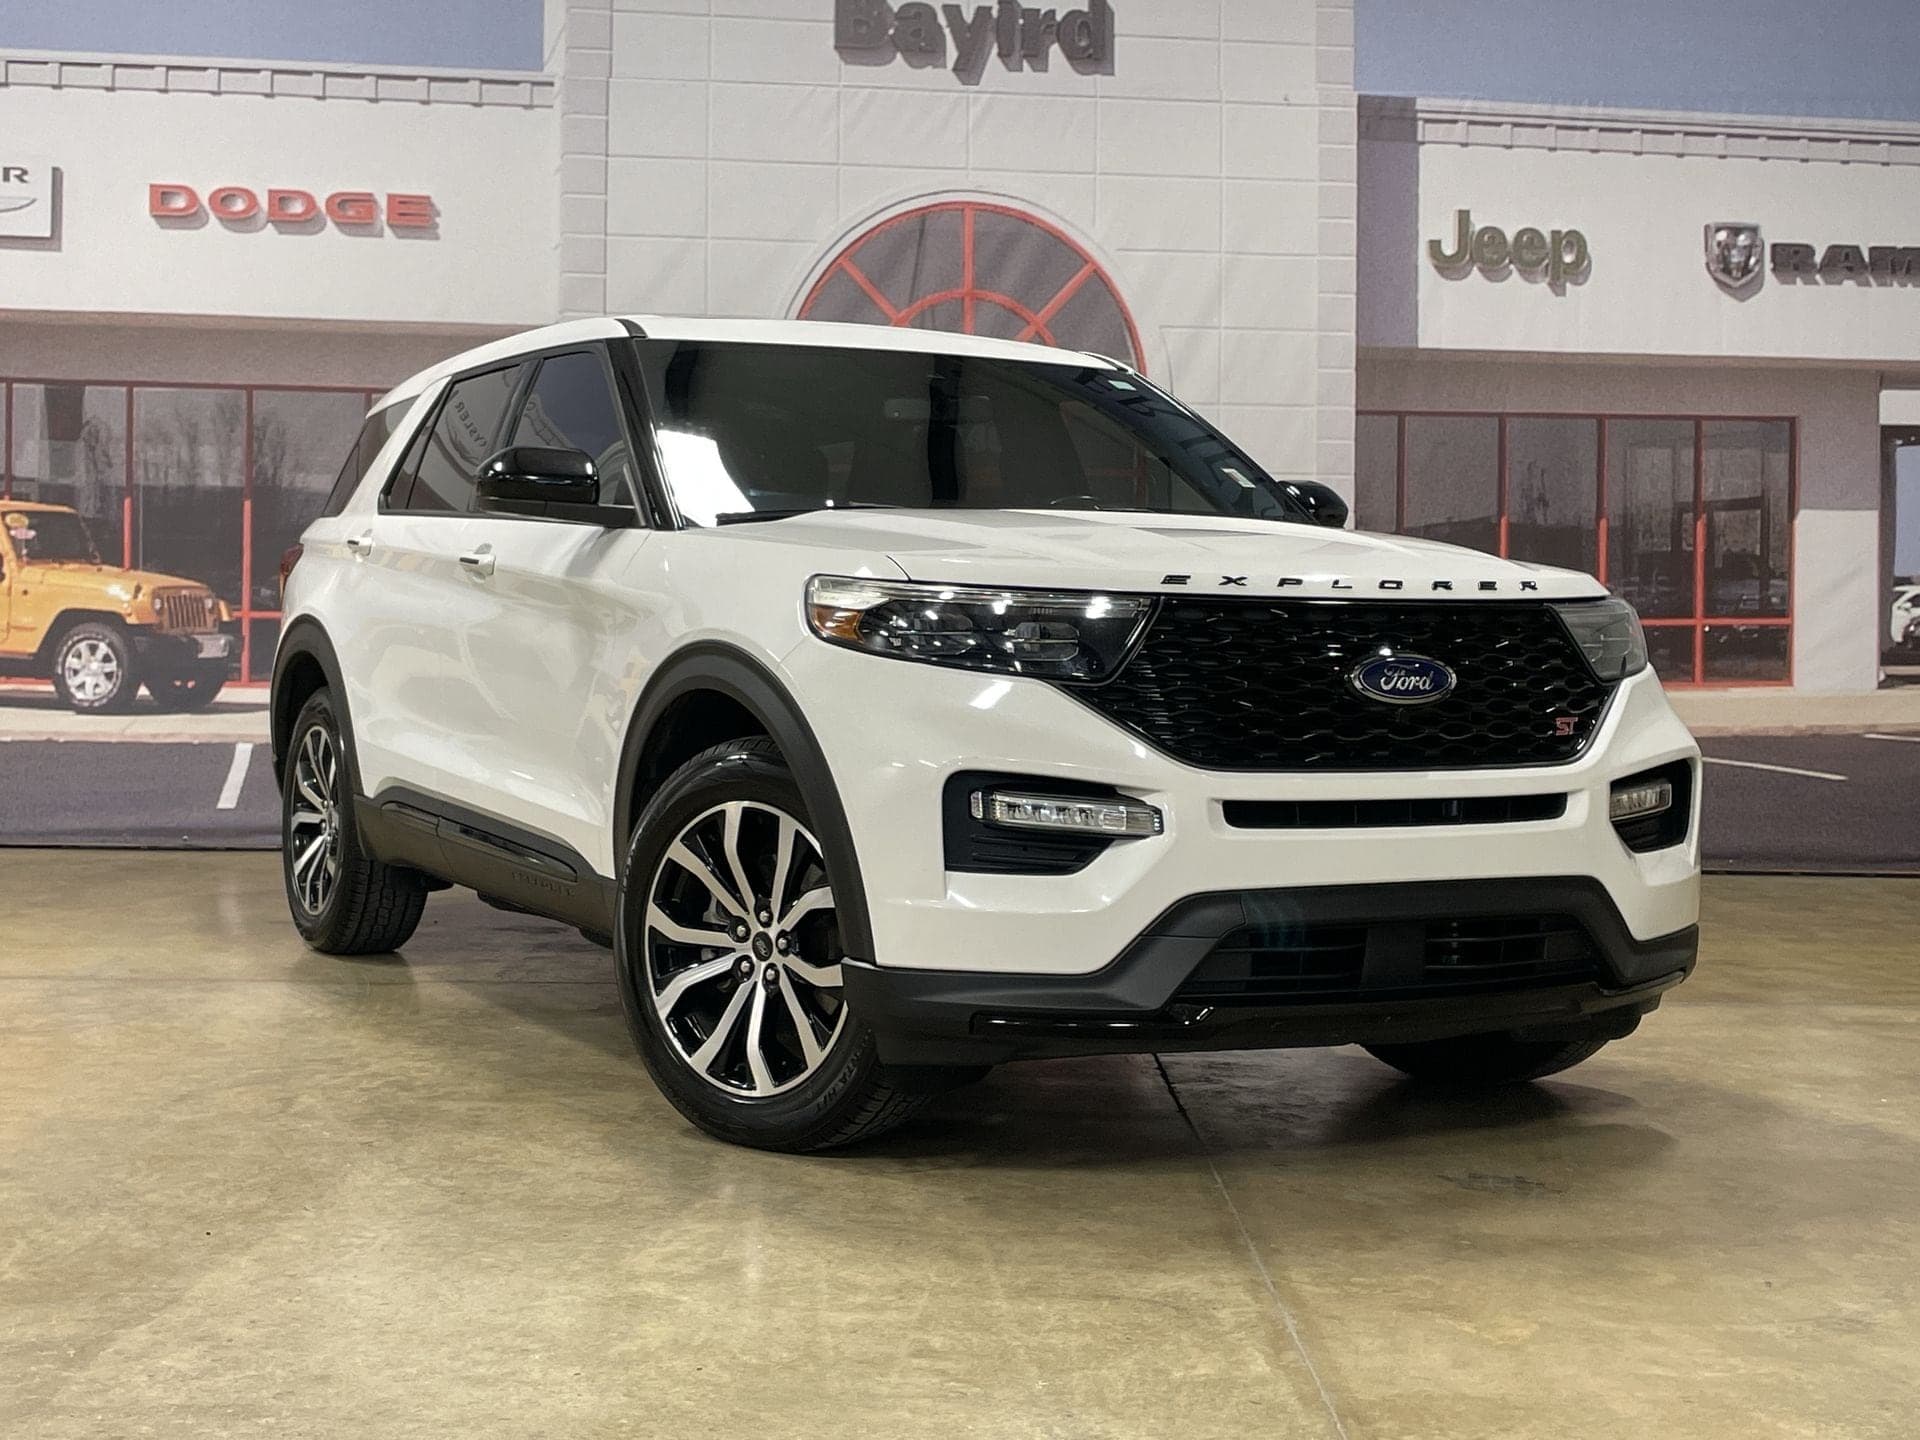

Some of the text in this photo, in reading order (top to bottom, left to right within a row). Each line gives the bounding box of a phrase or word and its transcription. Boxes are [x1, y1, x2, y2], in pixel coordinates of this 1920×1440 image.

[149, 183, 433, 229] DODGE
[1428, 209, 1589, 290] Jeep
[1770, 243, 1920, 283] RAM
[1160, 574, 1539, 592] EXPLORER
[1380, 663, 1434, 691] Ford
[1555, 716, 1579, 736] ST
